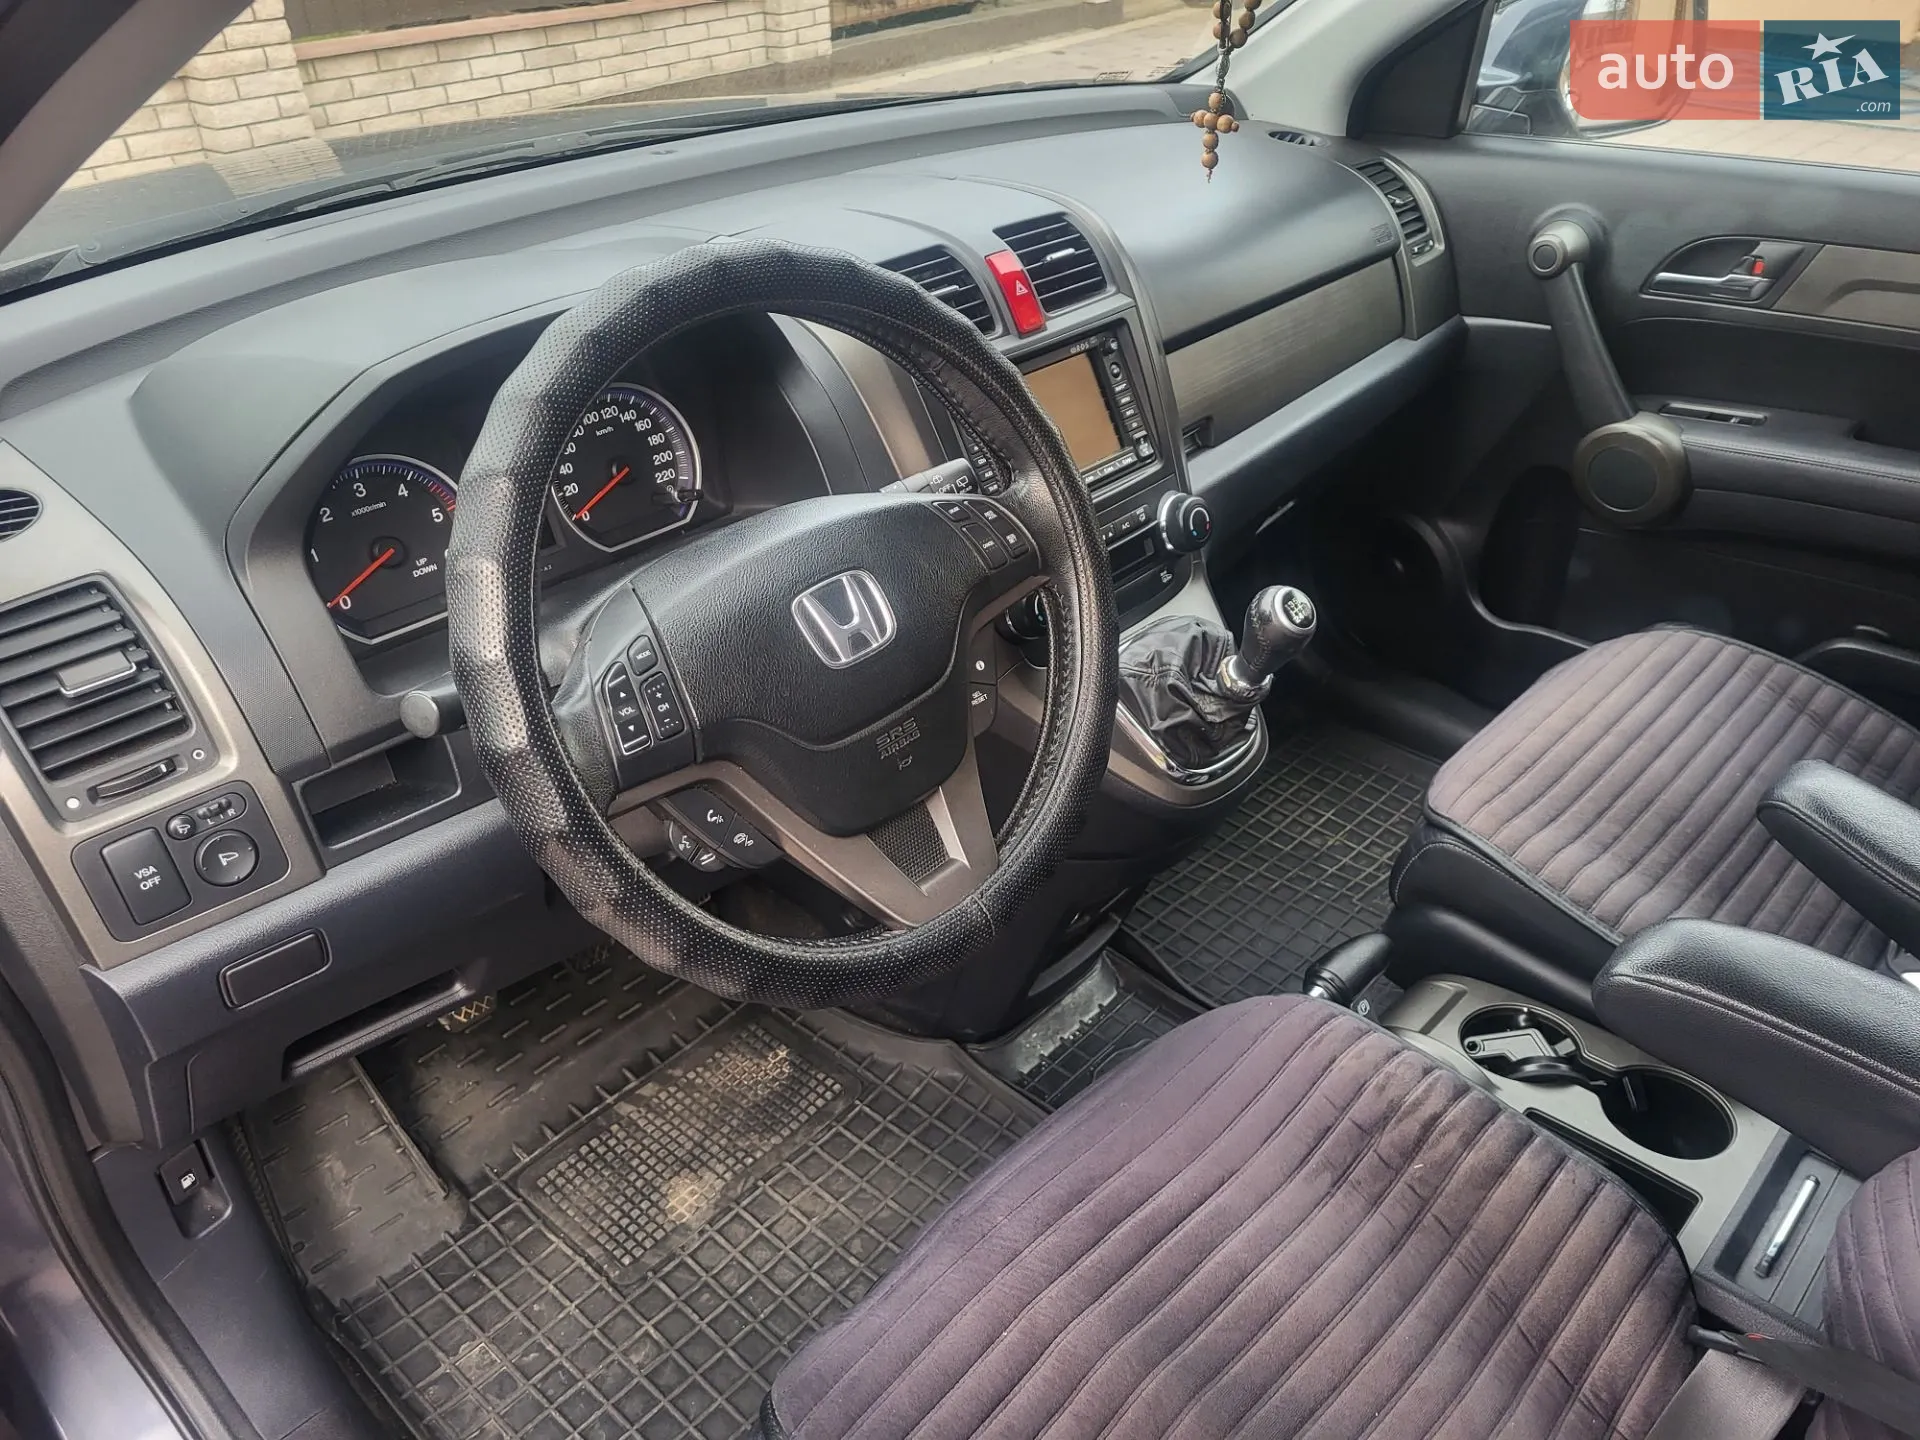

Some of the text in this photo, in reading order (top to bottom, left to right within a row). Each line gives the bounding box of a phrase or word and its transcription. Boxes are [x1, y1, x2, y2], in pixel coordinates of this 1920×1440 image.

[600, 405, 619, 420] 120
[619, 409, 637, 423] 140
[595, 425, 614, 437] km/h
[634, 418, 652, 433] 160
[647, 432, 665, 447] 180
[652, 450, 673, 466] 200
[559, 462, 573, 476] 40
[655, 468, 676, 484] 220
[353, 482, 367, 498] 3
[397, 483, 409, 498] 4
[563, 482, 579, 497] 20
[319, 507, 334, 523] 2
[431, 507, 444, 523] 5
[581, 510, 590, 522] 0
[310, 548, 320, 563] 1
[415, 557, 428, 567] UP
[412, 563, 438, 578] DOWN
[339, 595, 352, 610] 0
[618, 706, 636, 717] VOL
[657, 702, 670, 713] CH
[875, 717, 917, 748] SRS
[880, 729, 921, 760] AIRBAG
[227, 808, 237, 817] R
[133, 865, 158, 880] VSA
[139, 875, 162, 891] OFF
